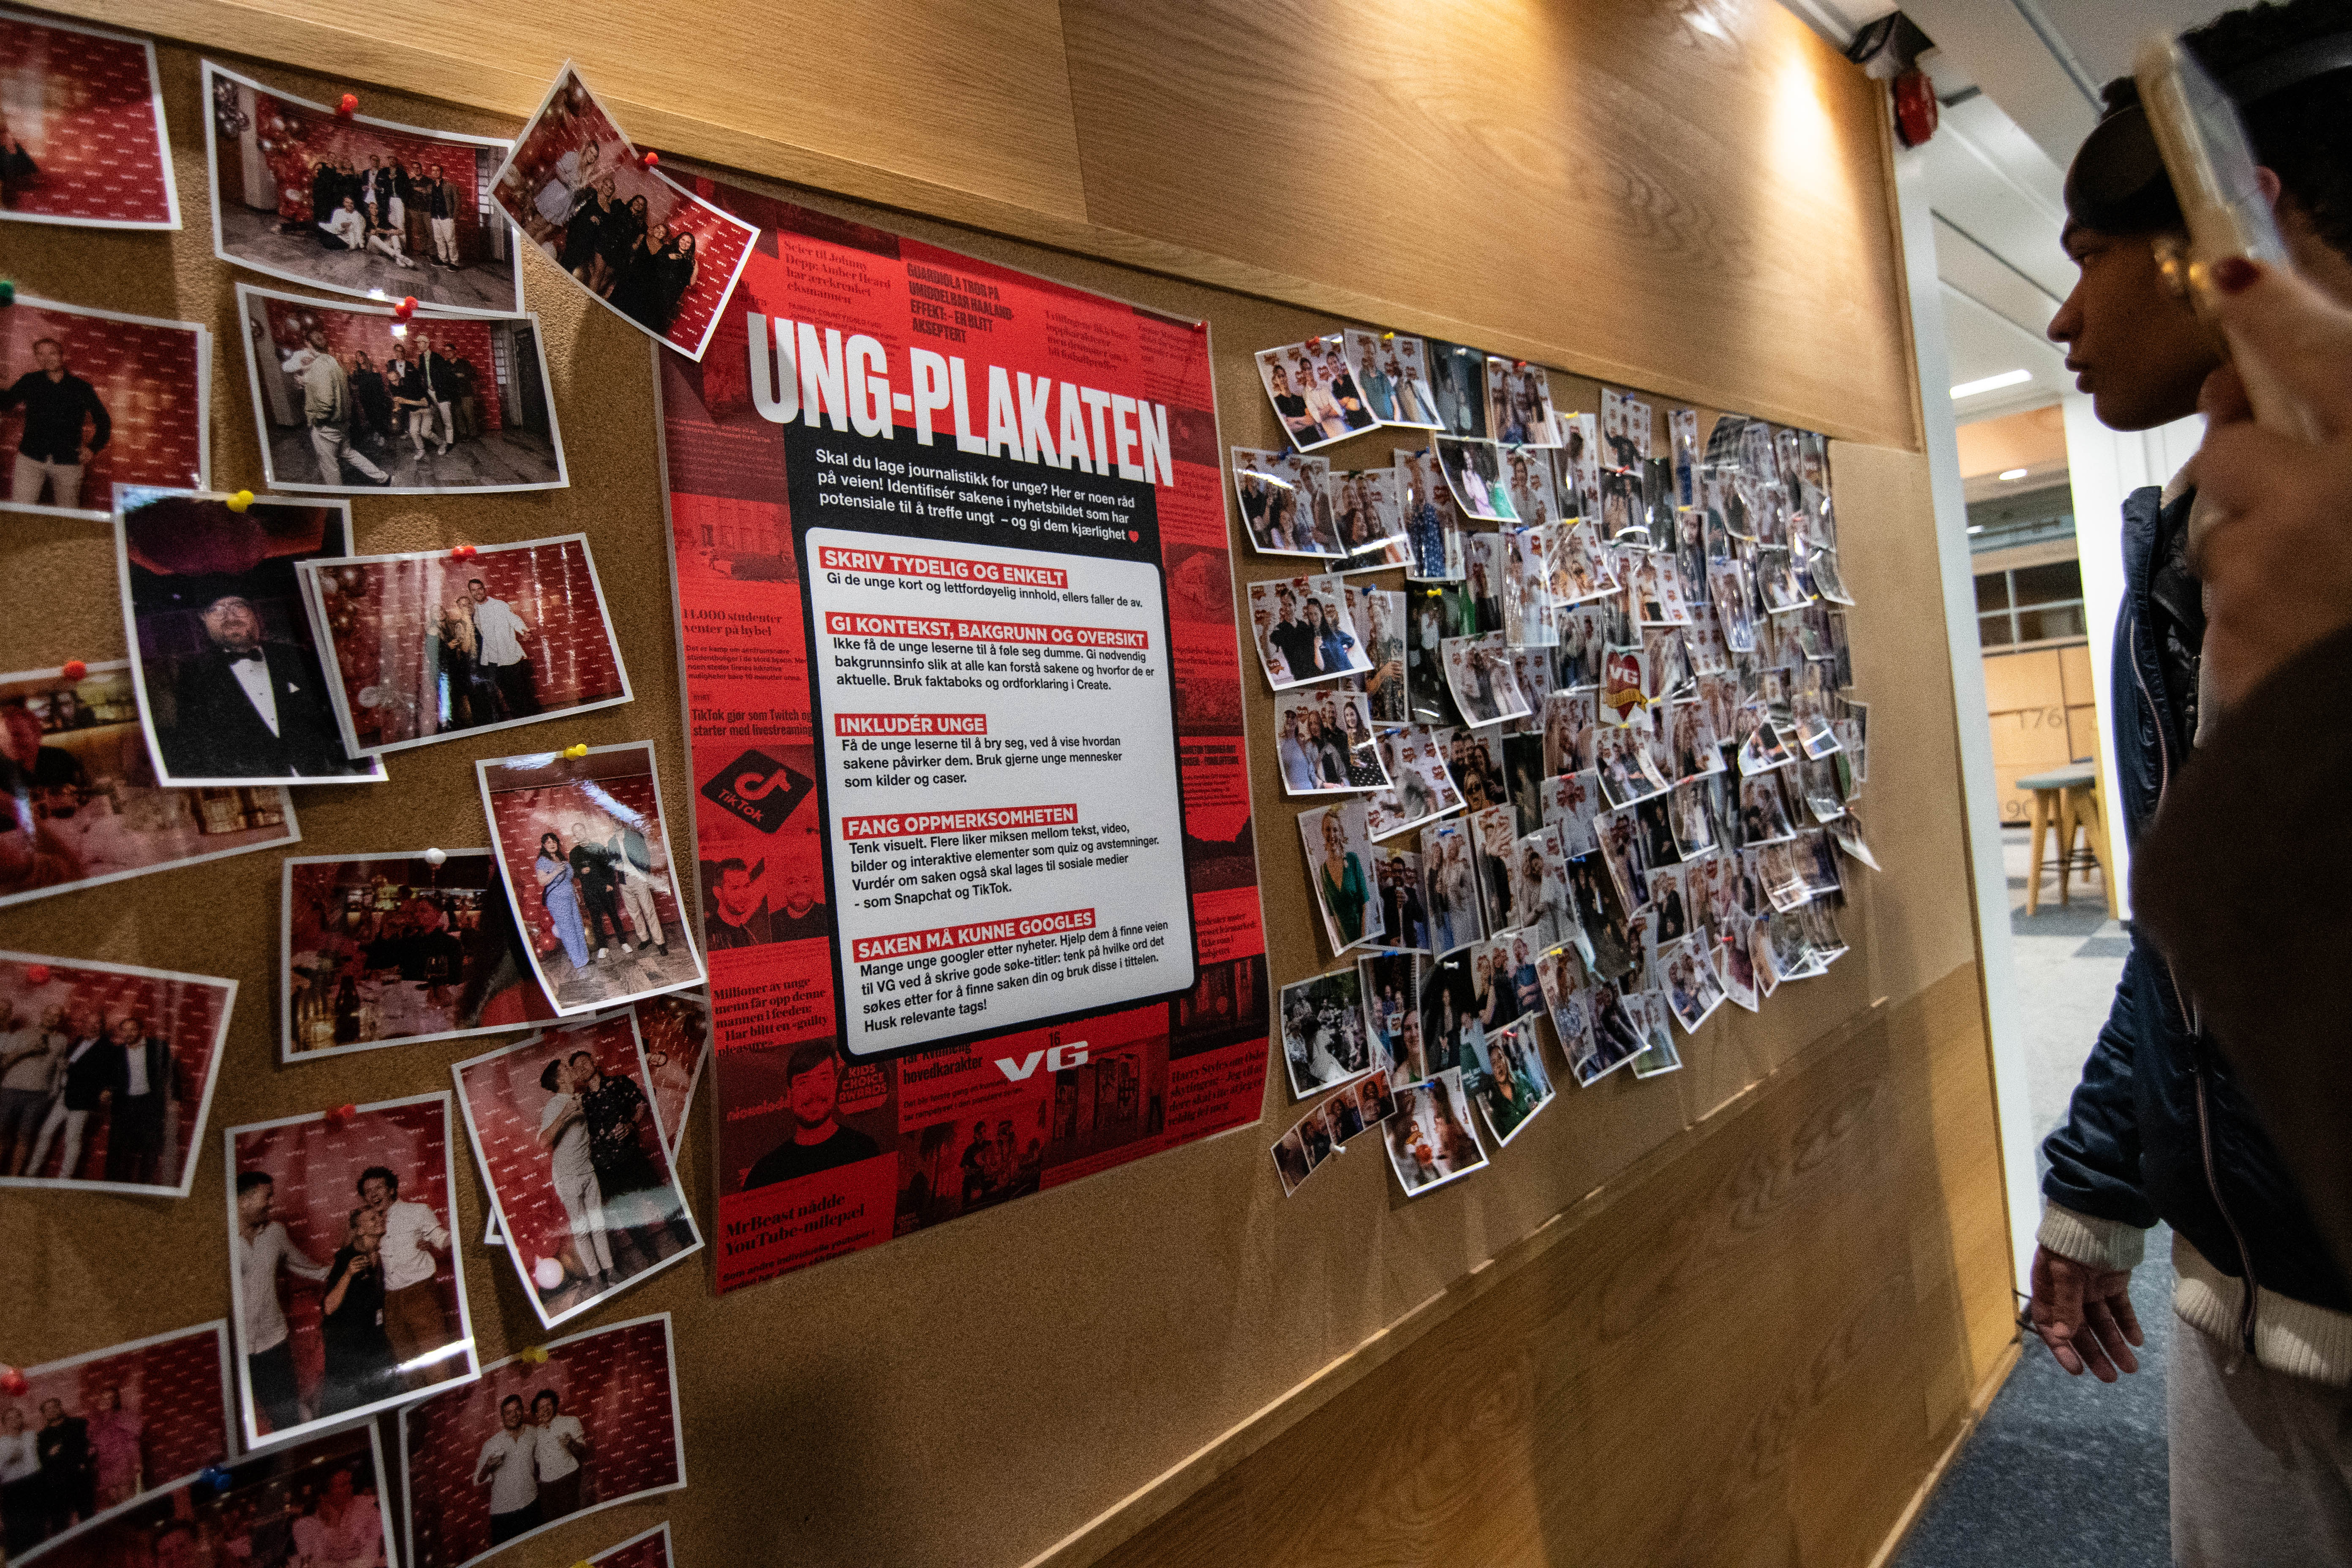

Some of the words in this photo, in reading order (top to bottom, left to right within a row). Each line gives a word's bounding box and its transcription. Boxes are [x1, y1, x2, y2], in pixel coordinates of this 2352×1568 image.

[783, 240, 813, 256] Seier
[814, 249, 827, 260] til
[828, 253, 867, 273] Johnny
[822, 263, 857, 280] Amber
[858, 272, 891, 290] Heard
[787, 281, 852, 305] eksmannen
[912, 317, 966, 343] AKSEPTERT
[747, 311, 1174, 487] UNG-PLAKATEN
[815, 448, 848, 466] Skal
[852, 454, 871, 469] du
[874, 457, 905, 476] lage
[908, 462, 989, 486] journalistikk
[991, 475, 1009, 489] for
[1012, 481, 1048, 496] unge?
[1050, 484, 1071, 498] Her
[1073, 490, 1086, 501] er
[1088, 493, 1115, 505] noen
[1117, 495, 1135, 508] råd
[817, 469, 836, 485] på
[840, 474, 883, 490] veien!
[887, 478, 955, 500] Identifisér
[958, 490, 1004, 506] sakene
[1006, 495, 1010, 507] i
[1013, 498, 1083, 518] nyhetsbildet
[1086, 509, 1109, 521] som
[1111, 510, 1129, 523] har
[819, 492, 895, 512] potensiale
[898, 500, 912, 513] til
[915, 501, 924, 515] å
[927, 504, 963, 520] treffe
[965, 511, 995, 526] ungt
[1010, 517, 1027, 531] og
[1029, 517, 1040, 532] gi
[1043, 518, 1069, 533] dem
[1071, 522, 1126, 541] kjærlighet
[825, 550, 884, 570] SKRIV
[889, 555, 969, 577] TYDELIG
[973, 564, 999, 580] OG
[1002, 566, 1063, 585] ENKELT
[826, 572, 841, 584] Gi
[844, 573, 860, 585] de
[864, 577, 895, 590] unge
[898, 577, 923, 591] kort
[926, 582, 941, 594] og
[943, 581, 1016, 600] lettfordøyelig
[1018, 587, 1060, 602] innhold,
[1062, 591, 1089, 603] ellers
[1090, 593, 1114, 605] faller
[1116, 596, 1128, 607] de
[1130, 599, 1143, 608] av.
[683, 608, 726, 620] 11.000
[727, 612, 783, 623] studenter
[683, 624, 722, 634] venter
[724, 626, 739, 637] på
[740, 624, 772, 637] hybel
[831, 615, 851, 632] GI
[856, 617, 954, 639] KONTEKST,
[958, 623, 1047, 641] BAKGRUNN
[1051, 628, 1073, 642] OG
[1077, 630, 1144, 646] OVERSIKT
[833, 637, 860, 650] Ikke
[863, 638, 876, 651] få
[879, 639, 895, 651] de
[898, 642, 928, 655] unge
[931, 641, 974, 654] leserne
[976, 643, 987, 655] til
[989, 643, 996, 655] å
[998, 644, 1019, 656] føle
[1021, 648, 1041, 659] seg
[1043, 646, 1083, 659] dumme.
[1085, 648, 1097, 659] Gi
[1098, 650, 1146, 664] nødvendig
[1609, 664, 1638, 685] VG
[691, 708, 724, 721] TikTok
[727, 711, 746, 724] gjør
[747, 711, 768, 721] som
[769, 708, 799, 721] Twitch
[693, 724, 727, 736] starter
[729, 724, 750, 736] med
[840, 715, 933, 733] INKLUDÉR
[936, 717, 984, 732] UNGE
[719, 788, 763, 822] TikTok
[848, 818, 900, 836] FANG
[904, 807, 1073, 832] OPPMERKSOMHETEN
[848, 841, 880, 854] Tenk
[883, 837, 927, 852] visuelt.
[930, 836, 959, 848] Flere
[962, 833, 987, 845] liker
[989, 830, 1028, 843] miksen
[1031, 827, 1069, 840] mellom
[1070, 825, 1099, 836] tekst,
[1101, 822, 1130, 834] video,
[858, 935, 921, 958] SAKEN
[926, 928, 954, 948] MÅ
[958, 922, 1015, 944] KUNNE
[1019, 912, 1092, 935] GOOGLES
[860, 961, 904, 977] Mange
[906, 956, 937, 970] unge
[940, 948, 985, 967] googler
[987, 945, 1013, 957] etter
[1015, 938, 1057, 954] nyheter.
[1059, 932, 1086, 947] Hjelp
[1088, 930, 1110, 941] dem
[1111, 926, 1118, 938] å
[1119, 925, 1143, 936] finne
[1144, 920, 1168, 932] veien
[713, 985, 768, 1000] Millioner
[769, 983, 781, 992] av
[783, 978, 811, 990] unge
[714, 1002, 749, 1015] menn
[750, 997, 768, 1009] får
[768, 995, 791, 1007] opp
[791, 989, 826, 1002] denne
[715, 1013, 764, 1029] mannen
[765, 1010, 770, 1020] i
[864, 1015, 897, 1032] Husk
[900, 1006, 956, 1026] relevante
[958, 998, 987, 1015] tags!
[725, 1029, 748, 1042] Har
[749, 1024, 774, 1037] blitt
[775, 1023, 790, 1032] en
[1048, 1031, 1061, 1047] 16
[848, 1063, 876, 1078] KIDS
[903, 1056, 983, 1085] hovedkarakter
[994, 1040, 1089, 1082] VG
[838, 1082, 887, 1102] AWARDS
[841, 1071, 884, 1091] CHOICE
[726, 1207, 794, 1236] MrBeast
[797, 1193, 845, 1217] nådde
[725, 1203, 864, 1256] YouTube-milepæl
